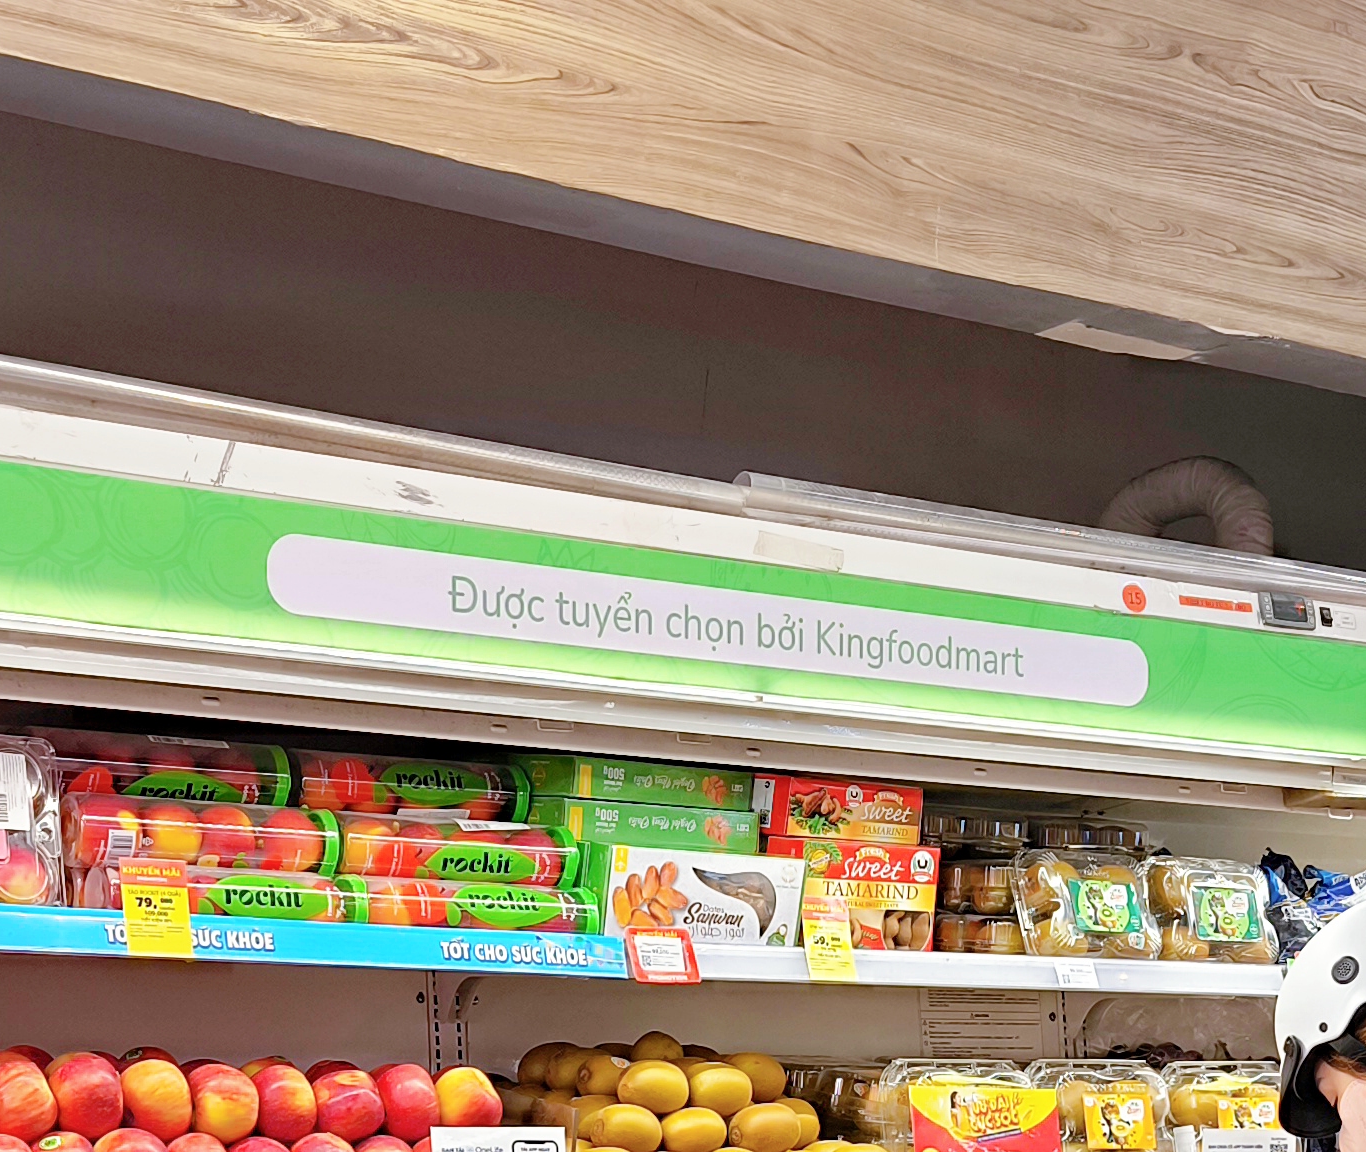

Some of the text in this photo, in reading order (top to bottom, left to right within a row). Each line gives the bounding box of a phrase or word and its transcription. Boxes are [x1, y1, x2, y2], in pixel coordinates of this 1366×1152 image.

[1127, 592, 1142, 605] 15
[448, 573, 1026, 680] Được tuyển chọn bởi Kingfoodmart
[395, 769, 465, 793] rockit
[603, 765, 625, 780] 500g
[139, 781, 220, 800] rockit
[595, 807, 619, 821] 500g
[860, 802, 913, 823] Sweet
[862, 825, 908, 837] TAMARIND
[440, 851, 513, 876] rockit
[841, 858, 905, 880] Sweet
[225, 884, 303, 909] rockit
[467, 889, 541, 912] rockit
[823, 880, 919, 900] TAMARIND
[683, 901, 744, 927] Sanwan
[703, 904, 725, 913] Dates
[440, 938, 589, 968] TỐT CHO SỨC KHỎE
